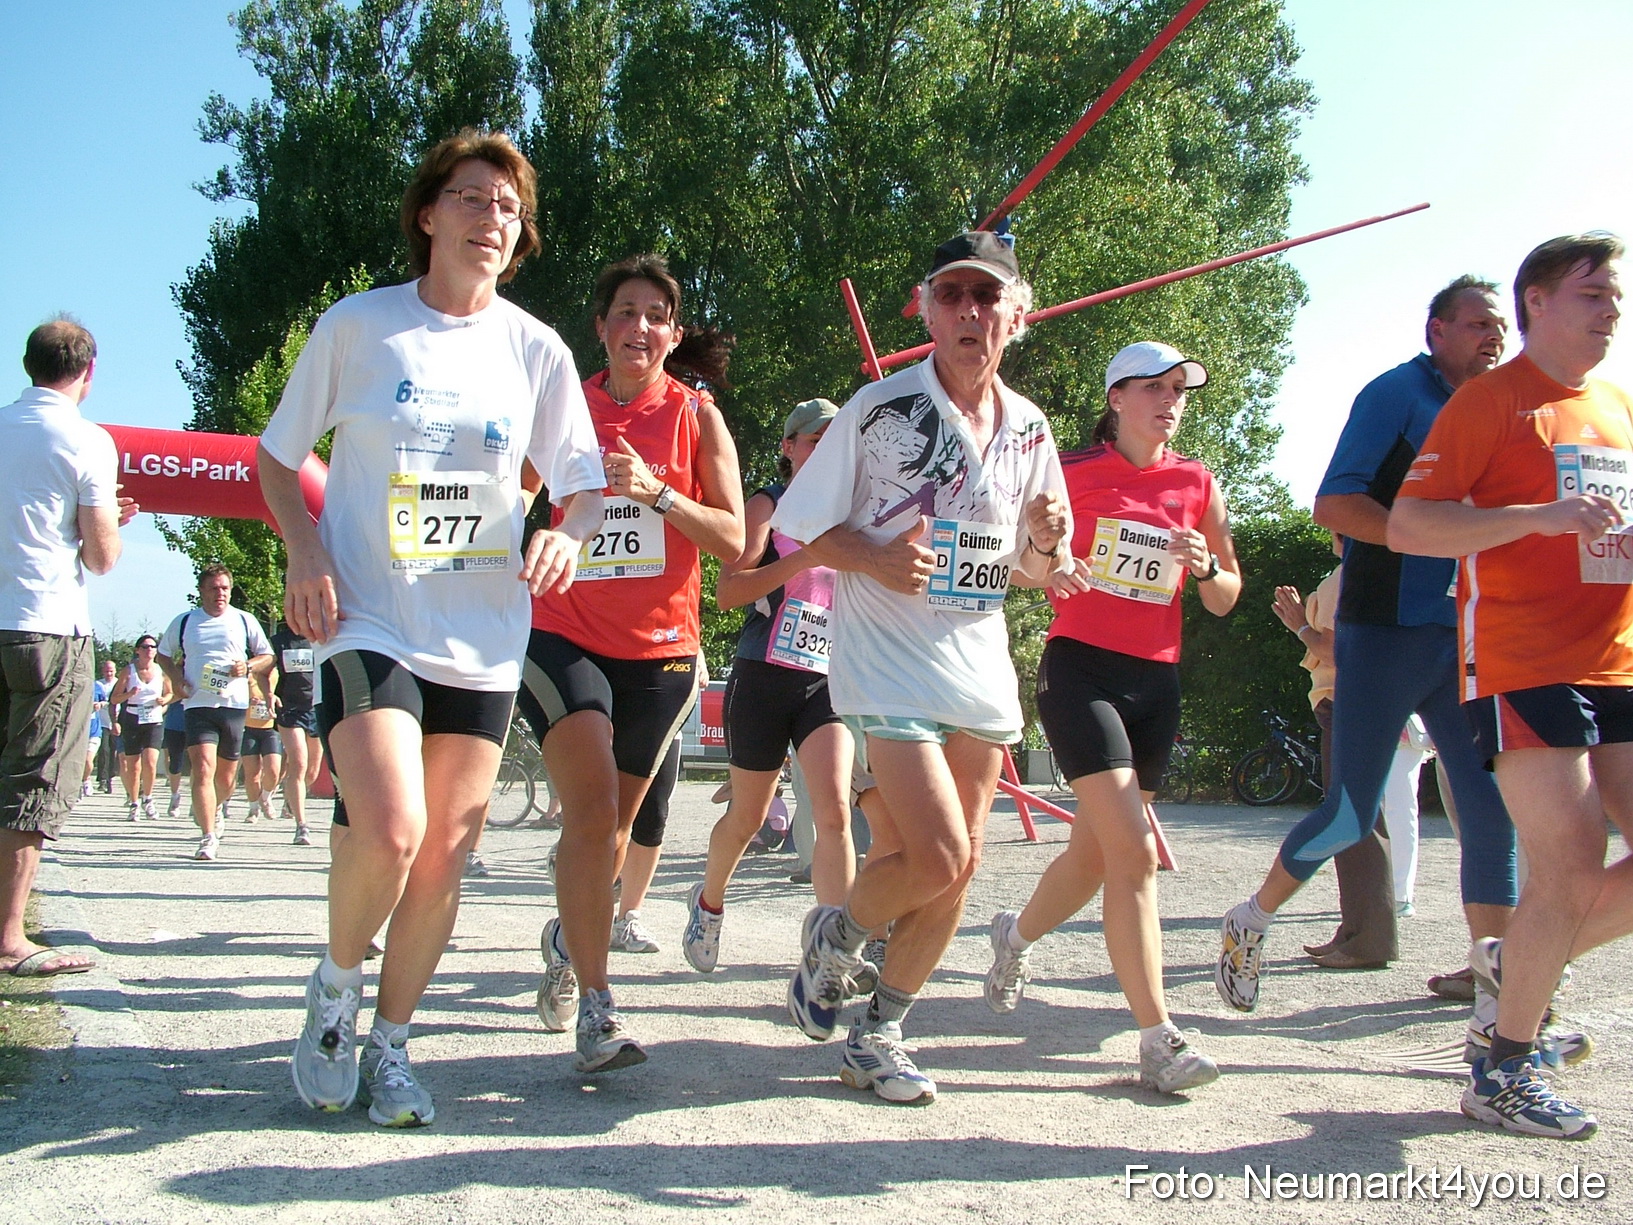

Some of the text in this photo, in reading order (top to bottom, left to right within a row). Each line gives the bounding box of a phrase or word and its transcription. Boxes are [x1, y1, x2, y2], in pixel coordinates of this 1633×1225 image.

[395, 380, 419, 403] 6.
[123, 452, 250, 482] LGS-Park
[1581, 454, 1627, 474] Michael
[421, 483, 469, 500] Maria
[1564, 476, 1575, 490] C
[397, 510, 409, 526] C
[604, 504, 640, 520] riede
[424, 515, 482, 544] 277
[592, 531, 640, 557] 276
[959, 531, 1002, 551] Günter
[1120, 528, 1169, 551] Daniela
[1097, 544, 1108, 556] D
[465, 556, 509, 568] PFLEIDERER
[625, 563, 664, 574] PFLEIDERER
[937, 553, 948, 567] D
[1116, 553, 1161, 581] 716
[957, 561, 1009, 590] 2608
[783, 621, 792, 633] D
[801, 610, 828, 628] Nicole
